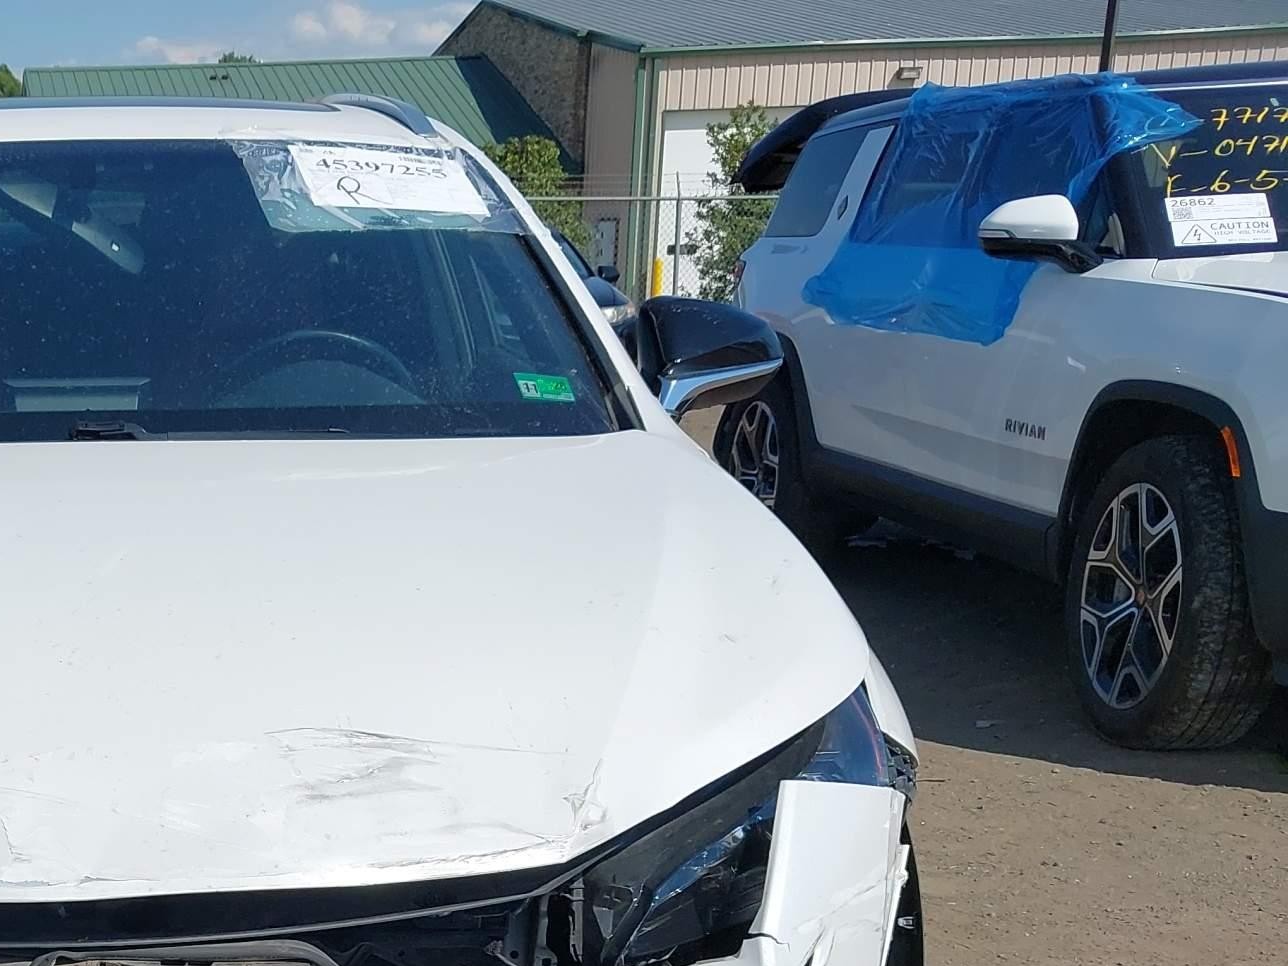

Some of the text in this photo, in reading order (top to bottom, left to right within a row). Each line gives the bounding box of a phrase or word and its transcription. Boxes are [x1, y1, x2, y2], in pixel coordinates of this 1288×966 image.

[316, 158, 448, 180] 45397255
[336, 175, 391, 205] R
[1171, 197, 1216, 208] 26862
[1210, 221, 1269, 231] CAUTION
[1005, 418, 1046, 440] RIVIAN
